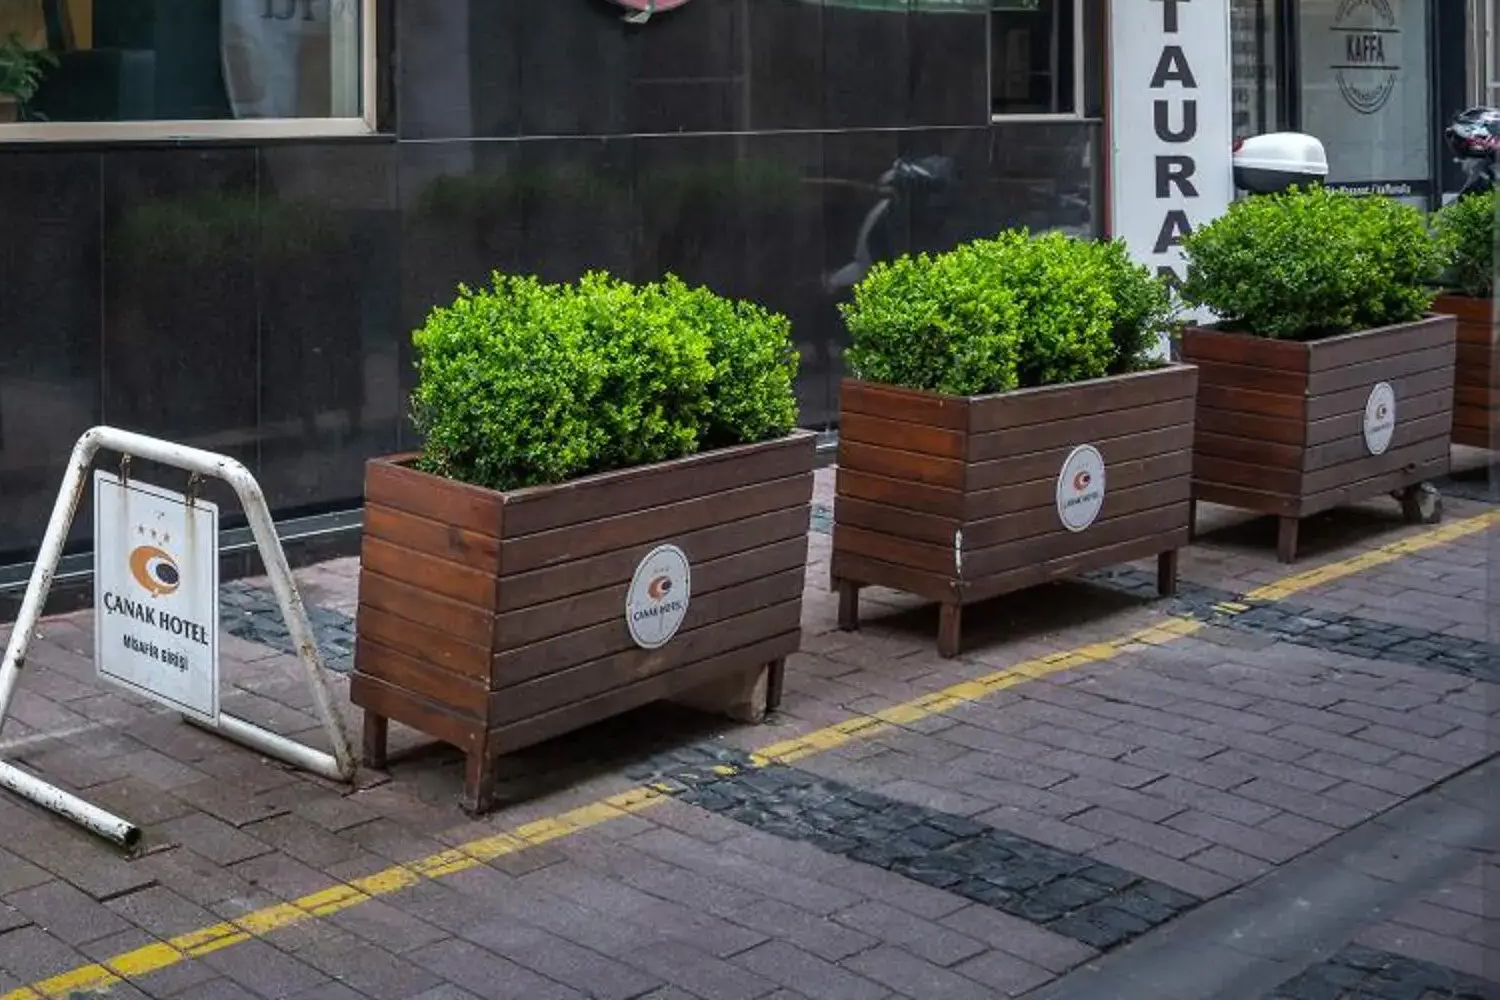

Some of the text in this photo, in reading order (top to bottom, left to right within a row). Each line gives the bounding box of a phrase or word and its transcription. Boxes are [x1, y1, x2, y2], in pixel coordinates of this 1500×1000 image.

[1346, 34, 1385, 63] KAFFA
[103, 591, 209, 646] ÇANAK HOTEL
